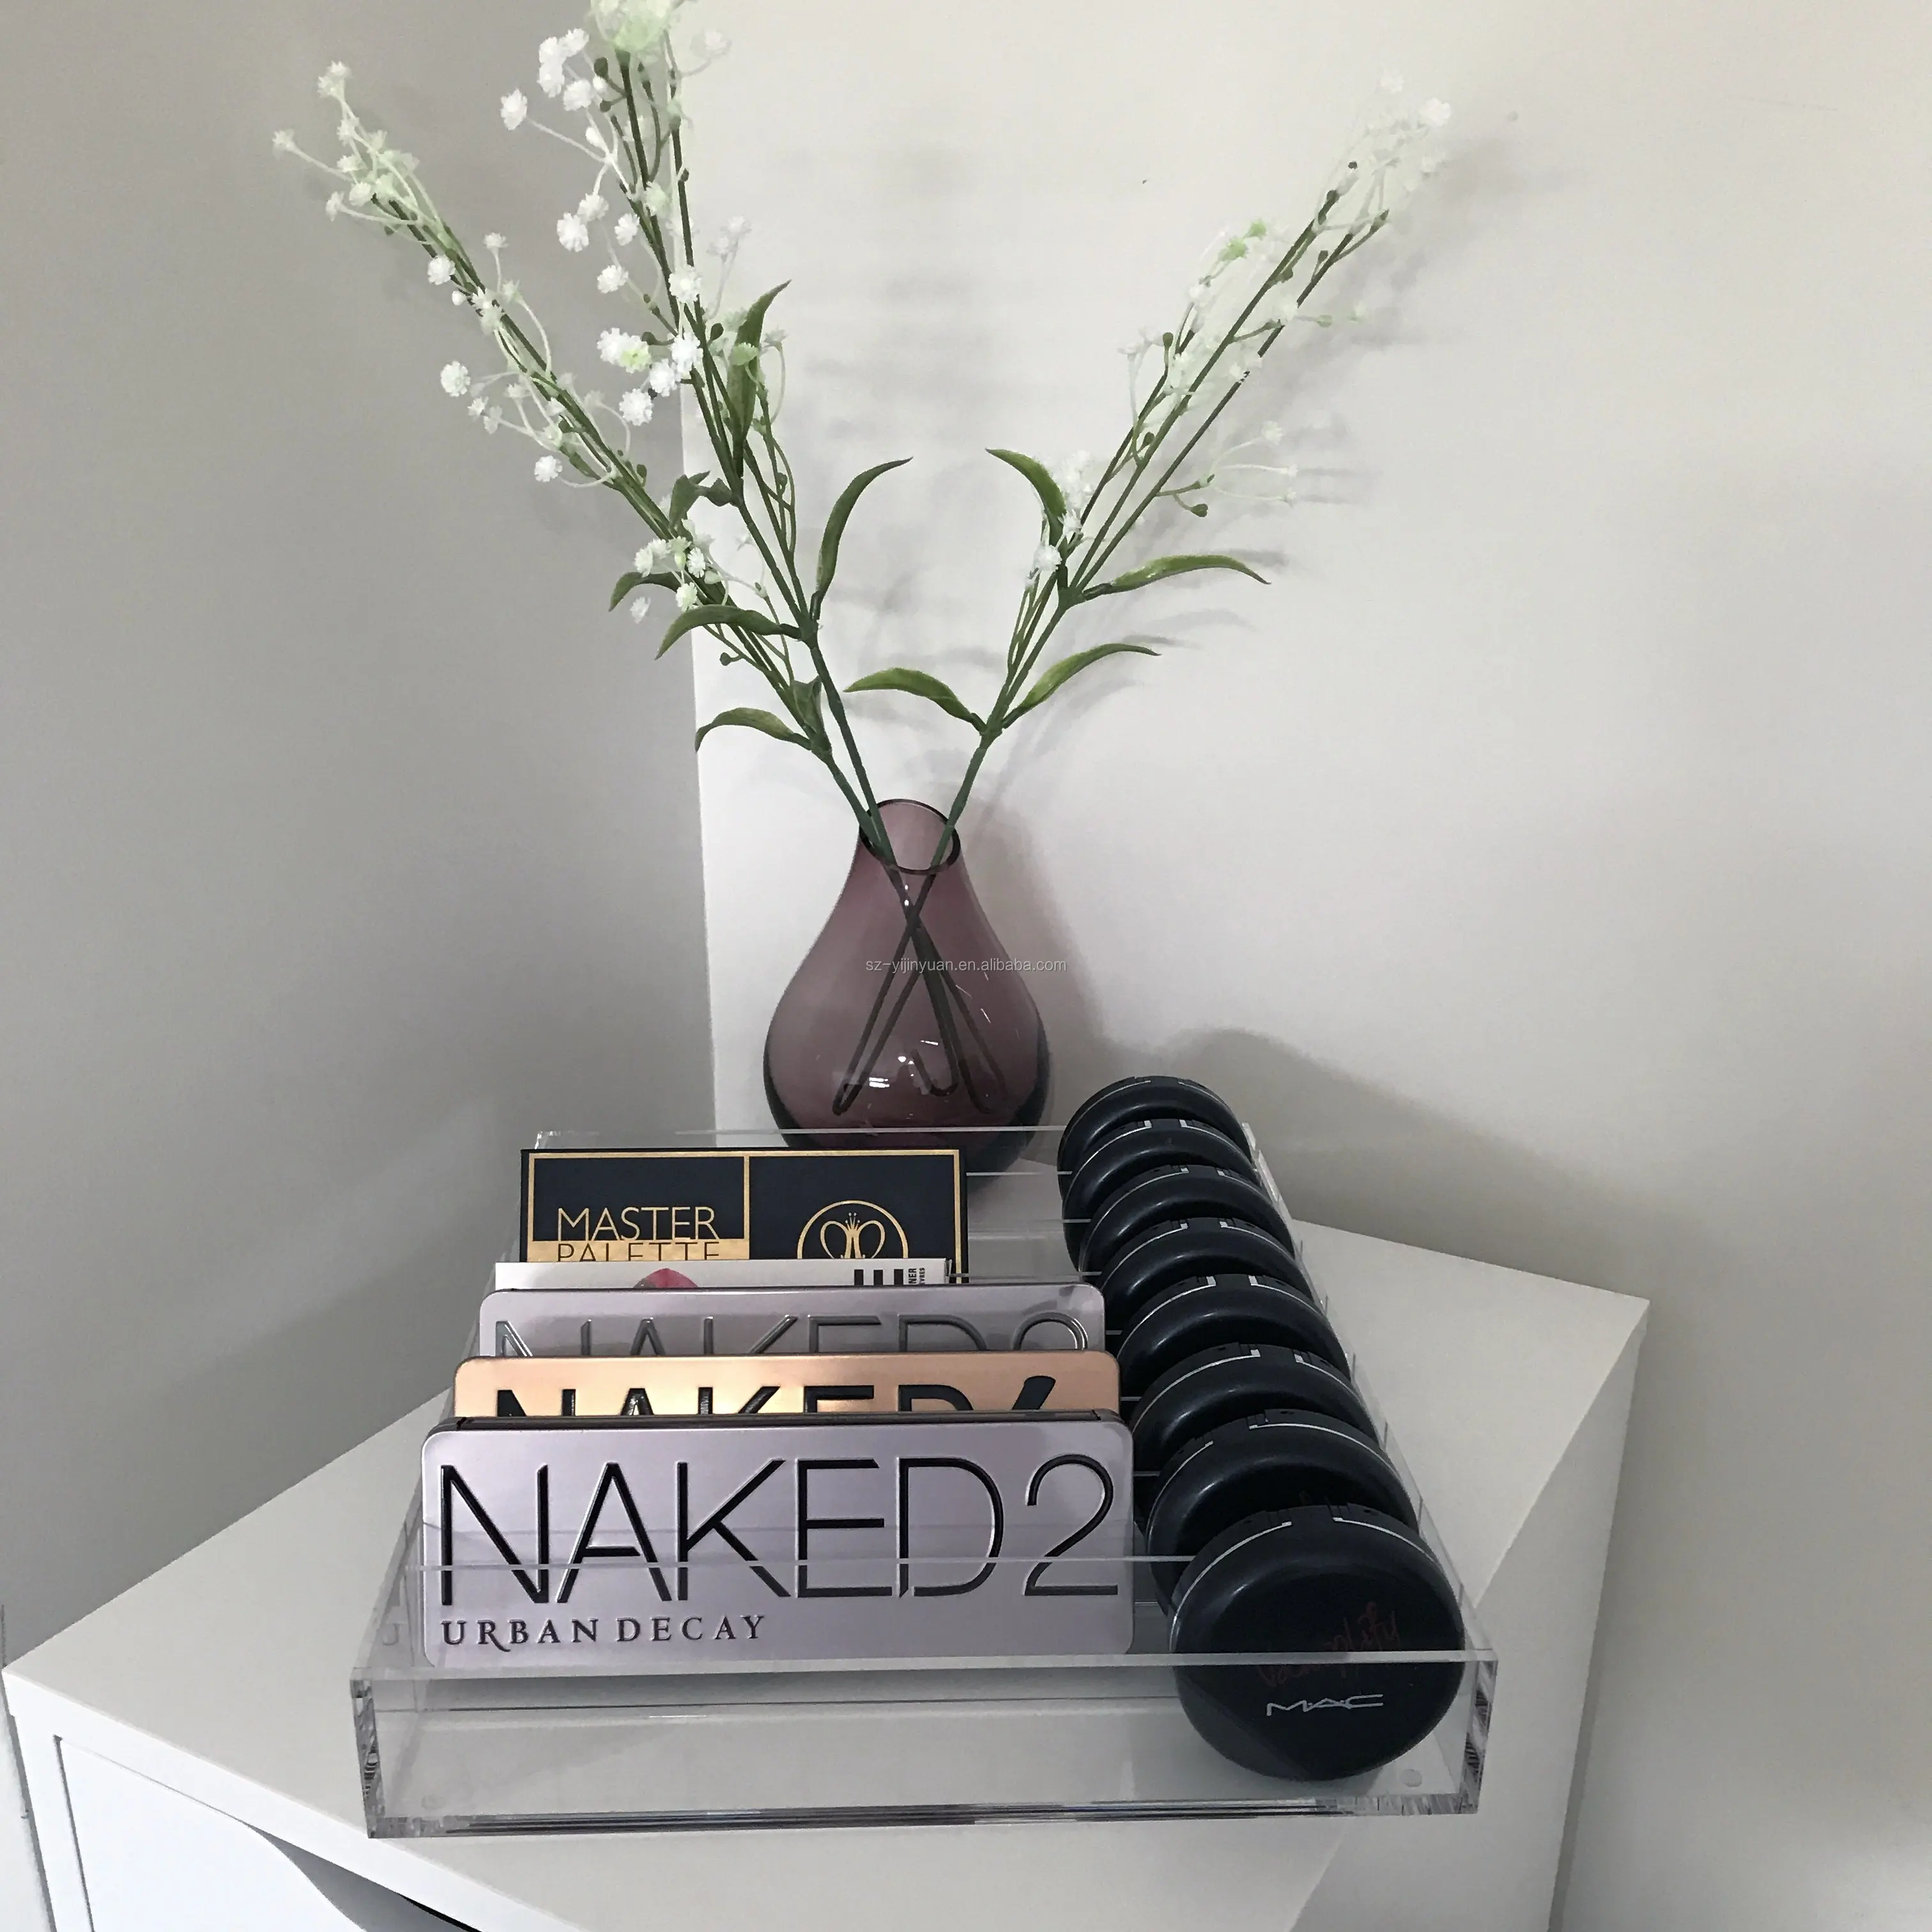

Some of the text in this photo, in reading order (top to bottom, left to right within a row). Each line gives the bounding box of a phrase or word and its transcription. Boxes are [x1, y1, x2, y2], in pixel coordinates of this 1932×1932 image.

[558, 1206, 720, 1241] MASTER
[441, 1615, 765, 1652] URBAN DECAY
